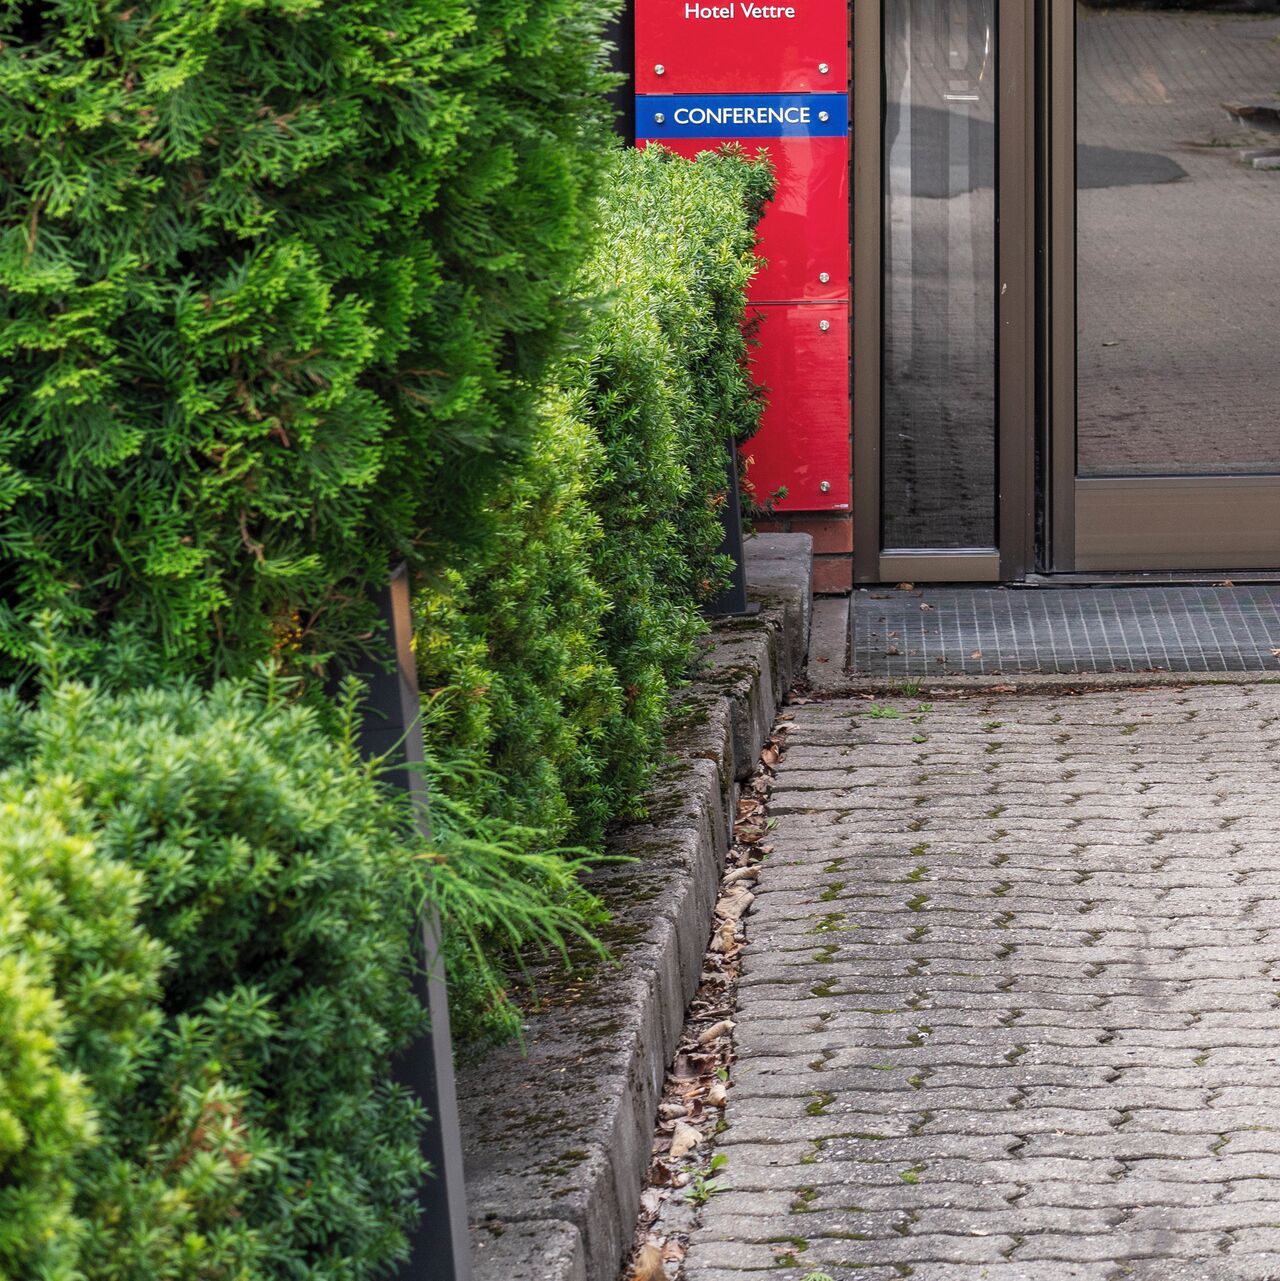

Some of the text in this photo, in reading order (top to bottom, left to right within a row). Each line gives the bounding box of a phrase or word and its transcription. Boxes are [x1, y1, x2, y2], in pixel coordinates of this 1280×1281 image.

[685, 3, 796, 19] Hotel Vettre
[674, 107, 811, 124] CONFERENCE
